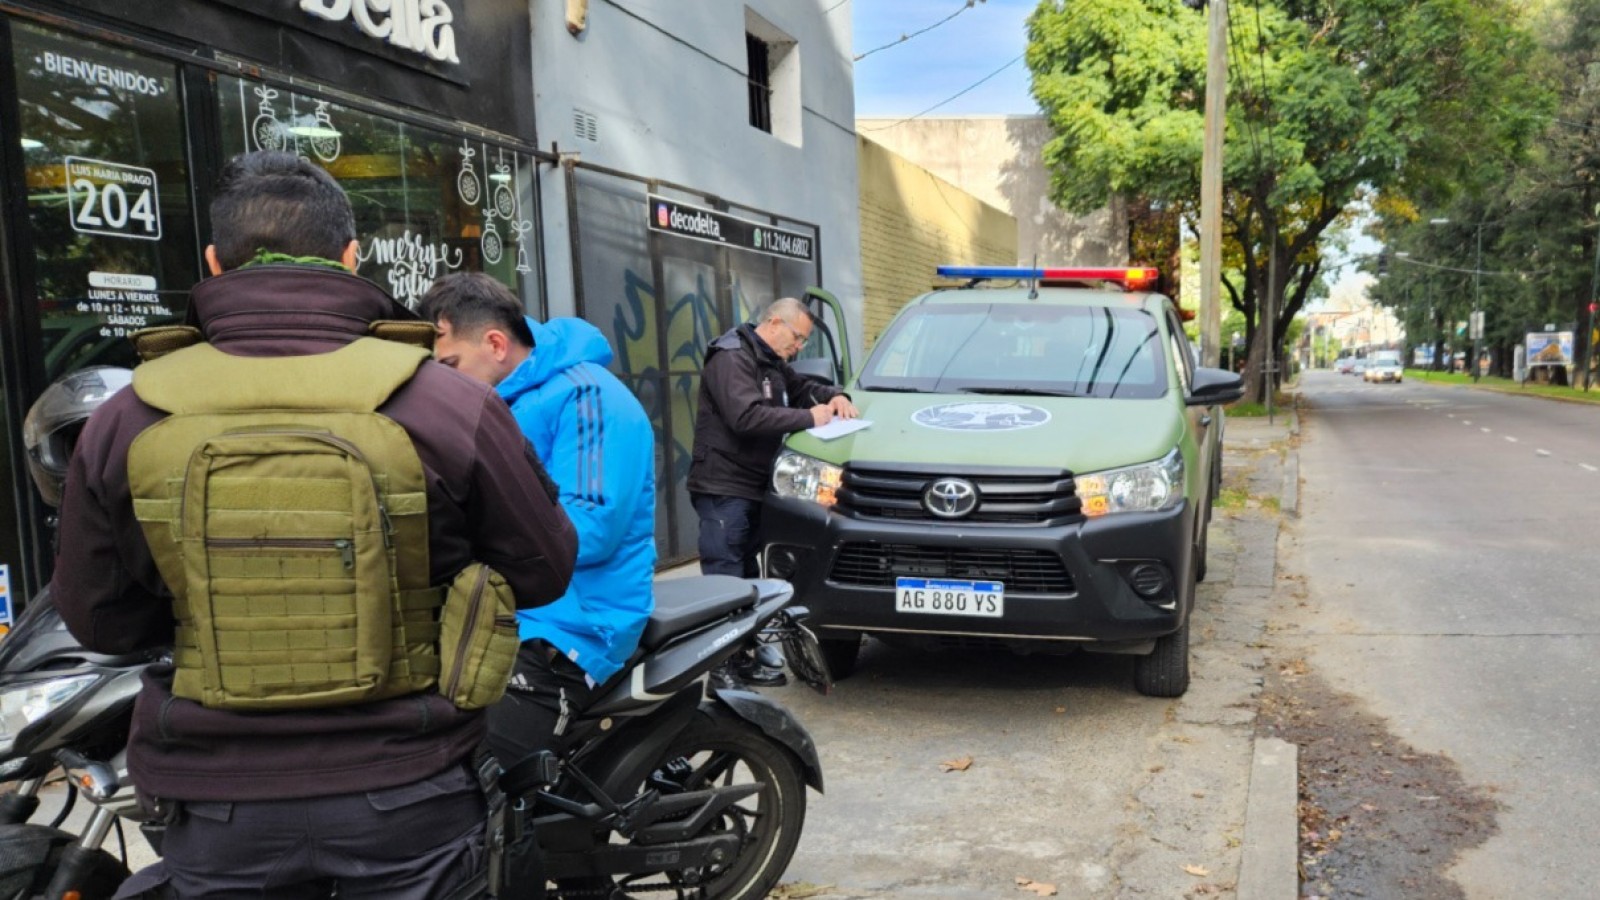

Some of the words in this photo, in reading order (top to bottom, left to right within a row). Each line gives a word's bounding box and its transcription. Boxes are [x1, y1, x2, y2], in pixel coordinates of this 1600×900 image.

[71, 164, 91, 177] LUIS
[122, 171, 152, 186] DRAGO
[73, 178, 156, 232] 204
[88, 289, 116, 300] LUNES
[118, 292, 124, 301] A
[125, 292, 159, 303] VIERNES
[77, 301, 89, 312] de
[91, 302, 103, 312] 10
[100, 326, 112, 337] de
[114, 327, 124, 337] 10
[902, 590, 925, 609] AG
[932, 591, 967, 611] 880
[974, 593, 997, 613] YS
